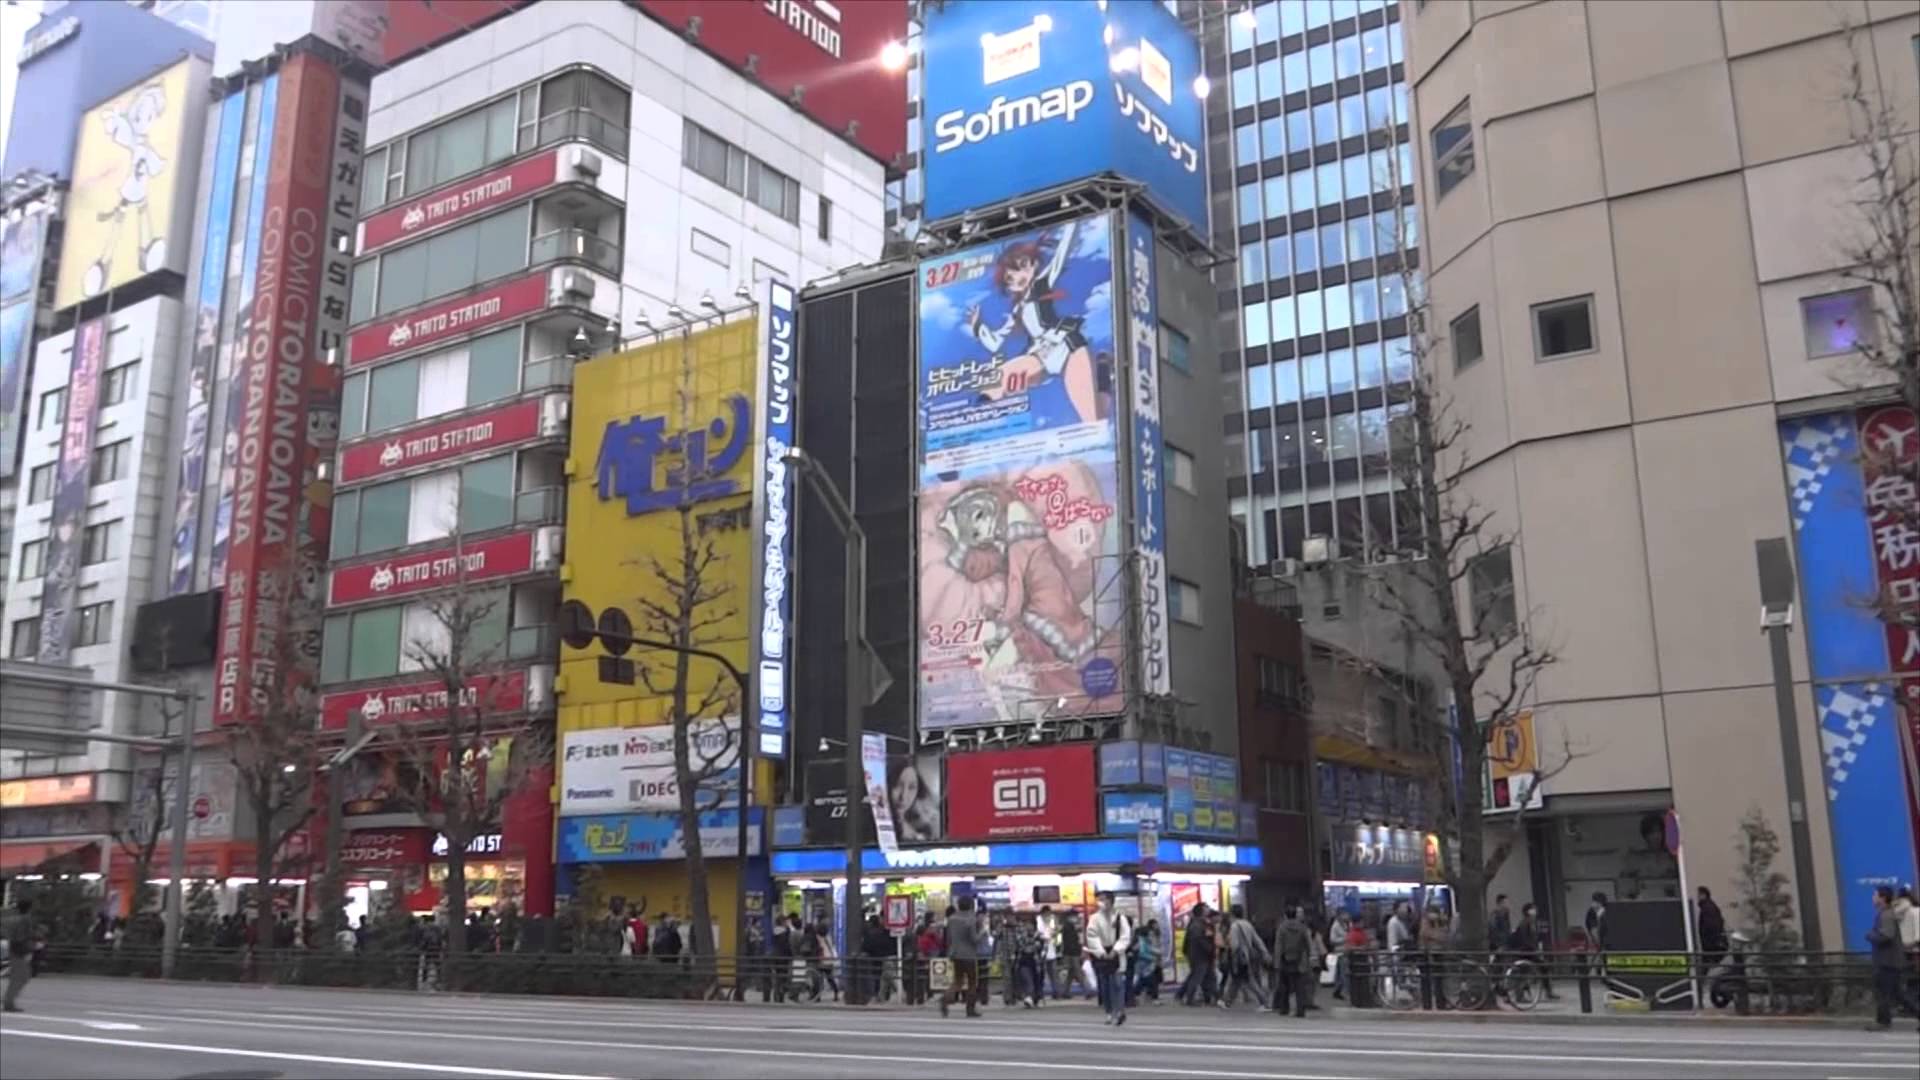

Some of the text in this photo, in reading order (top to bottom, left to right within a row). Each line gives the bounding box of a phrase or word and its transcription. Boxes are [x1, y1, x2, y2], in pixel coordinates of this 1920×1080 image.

[764, 0, 841, 58] STATION
[935, 80, 1093, 152] Sofmap
[1115, 82, 1198, 172] ソフマップ
[427, 175, 512, 219] TAITO STATION
[926, 262, 960, 288] 3.27
[414, 298, 500, 337] TAITO STATION
[770, 316, 791, 424] ソフマップ
[405, 422, 493, 459] TAITO STATION
[396, 551, 485, 585] TAITO STAION
[927, 618, 984, 648] 3.27
[567, 789, 614, 800] Panasonic
[640, 782, 676, 796] IDEC
